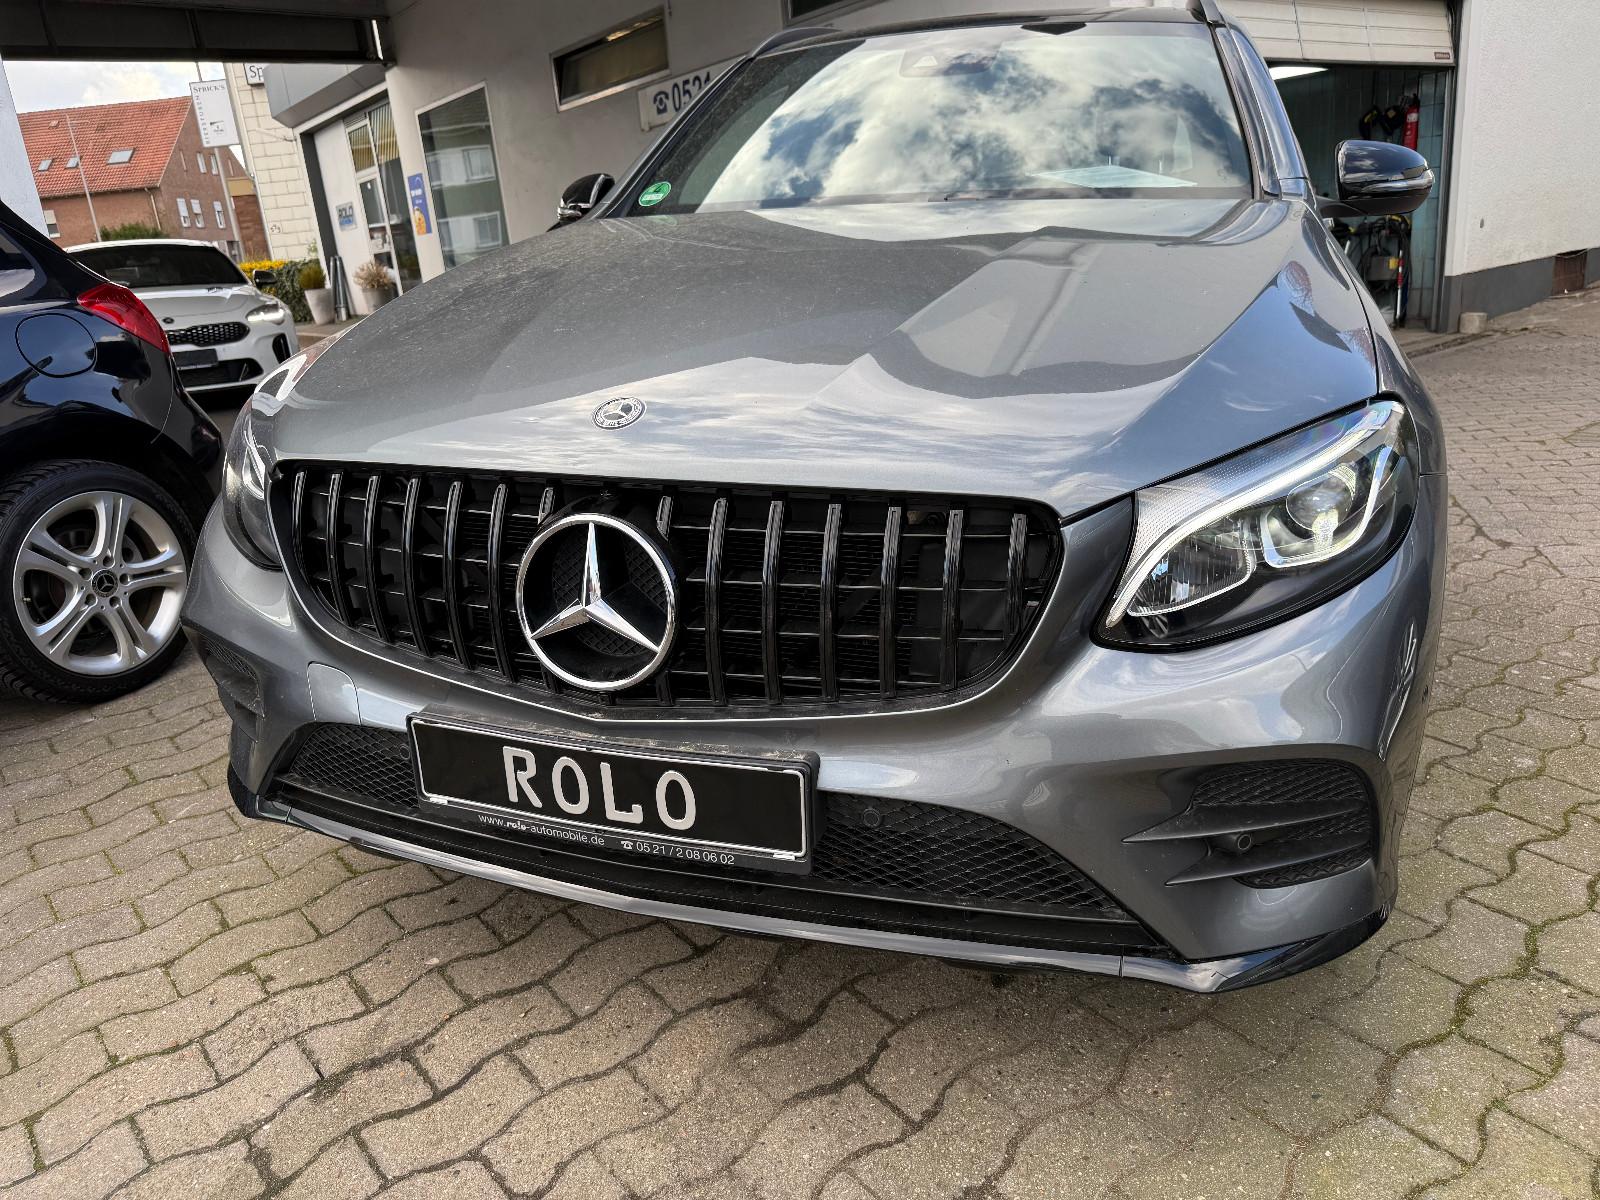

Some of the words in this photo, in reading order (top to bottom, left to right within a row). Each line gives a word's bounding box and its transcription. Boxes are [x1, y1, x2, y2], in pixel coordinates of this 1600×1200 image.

[502, 745, 697, 831] ROLO
[478, 814, 605, 846] www.rolo-automobile.de
[636, 841, 650, 852] 05
[652, 844, 666, 855] 21
[676, 848, 683, 858] 2
[685, 849, 701, 860] 08
[703, 851, 718, 863] 06
[720, 853, 734, 865] 02
